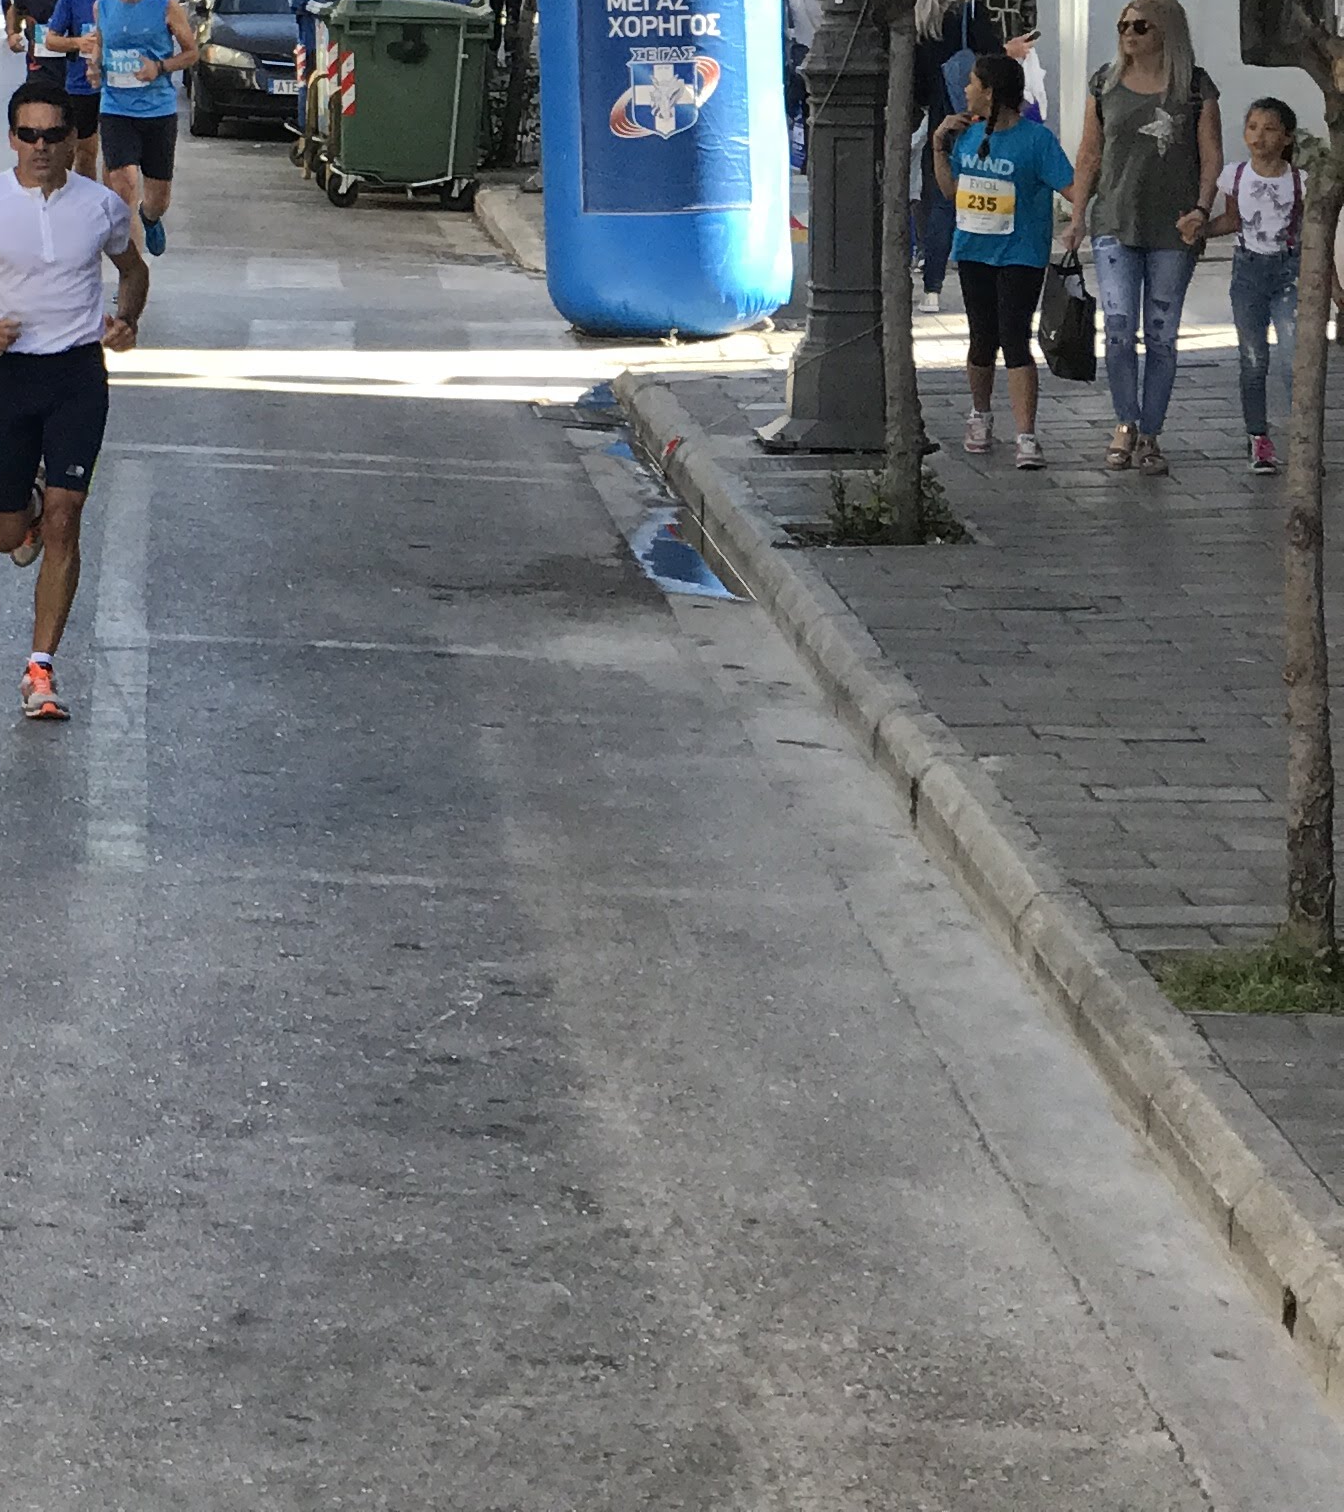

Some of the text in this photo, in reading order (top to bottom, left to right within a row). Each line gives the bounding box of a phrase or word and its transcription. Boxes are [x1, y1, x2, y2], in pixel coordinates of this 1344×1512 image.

[608, 13, 721, 38] ΧΟΡΗΓΟΣ
[629, 46, 697, 62] ΣΕΓΑΣ
[967, 194, 997, 212] 235
